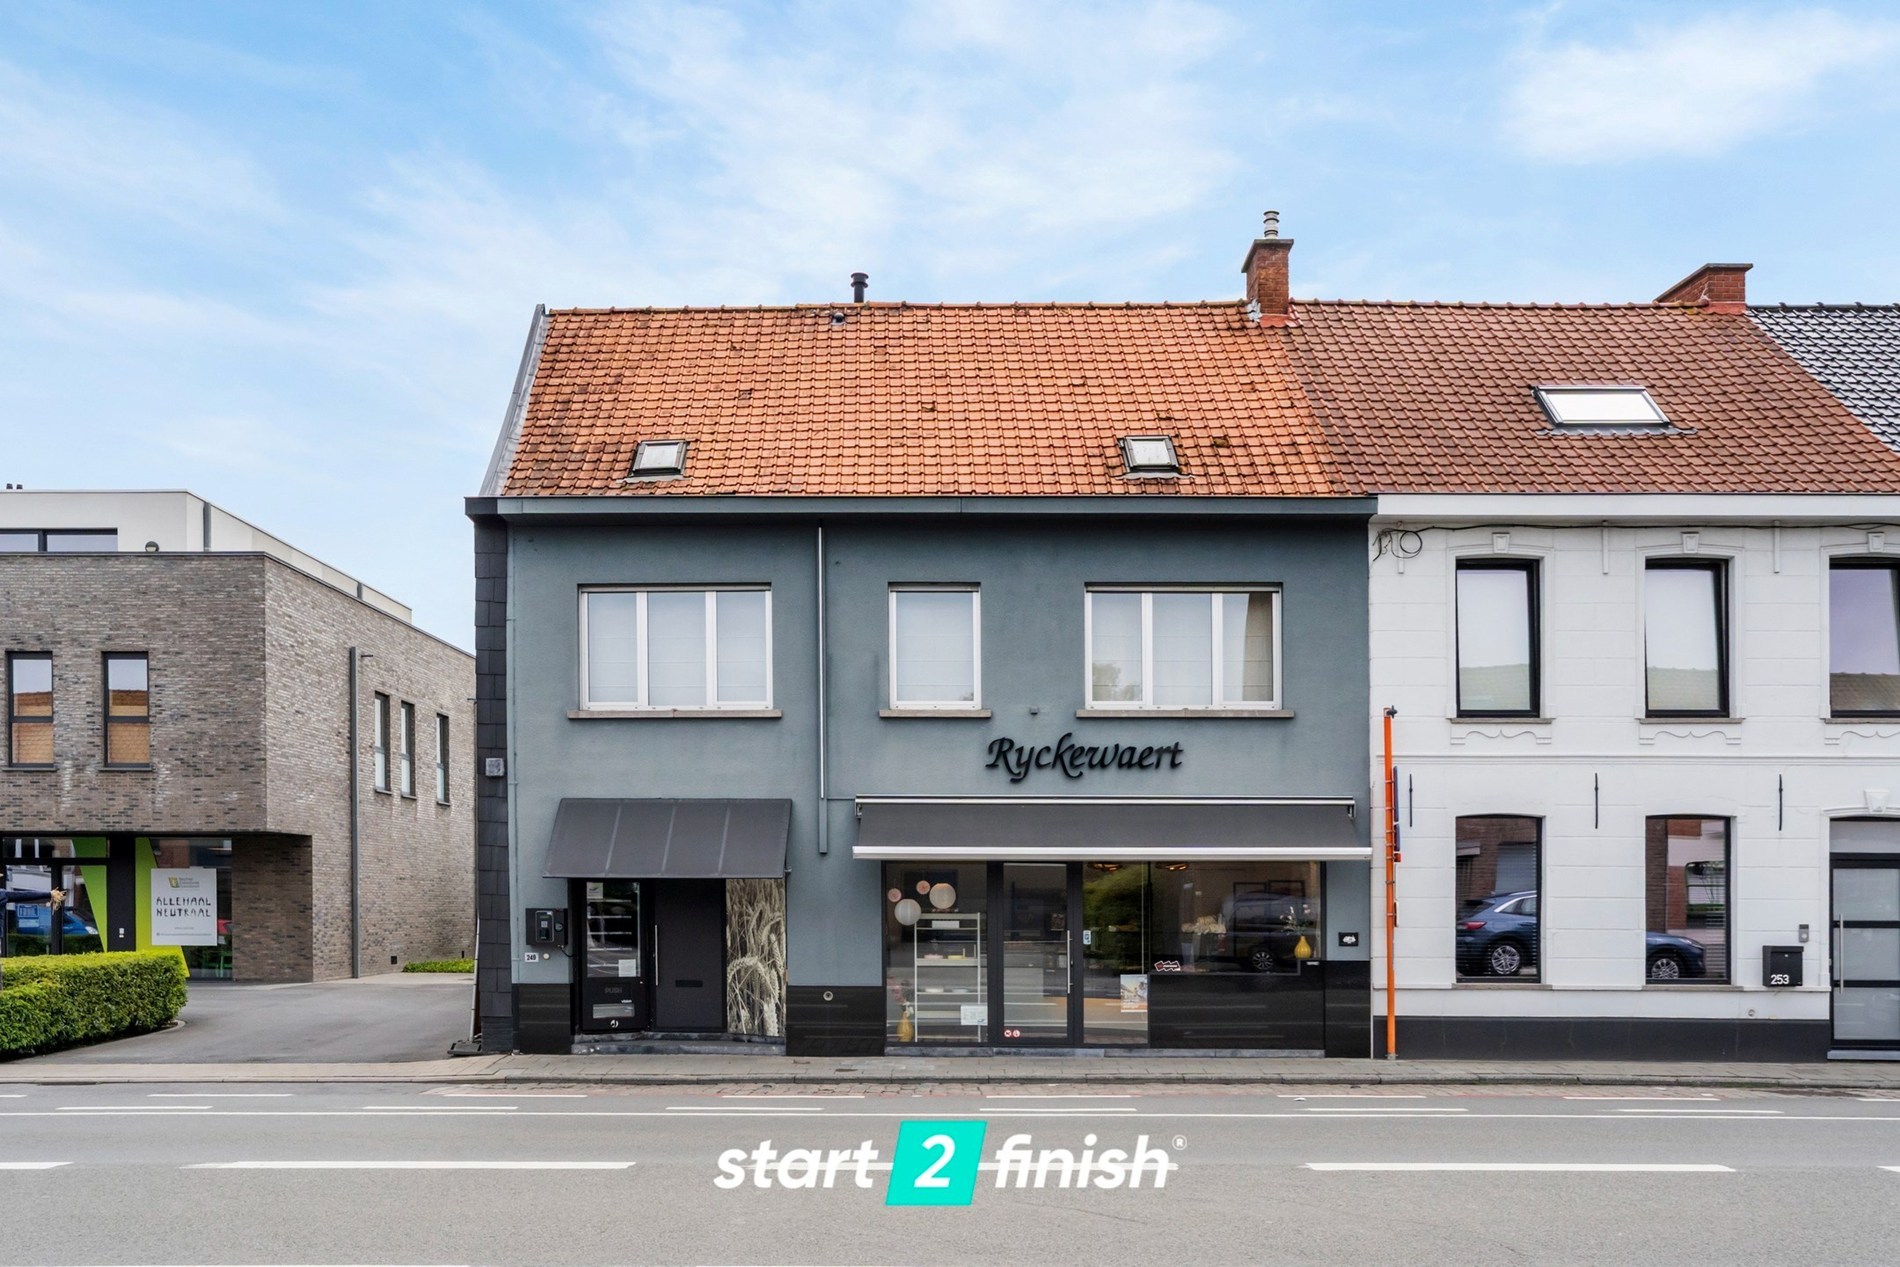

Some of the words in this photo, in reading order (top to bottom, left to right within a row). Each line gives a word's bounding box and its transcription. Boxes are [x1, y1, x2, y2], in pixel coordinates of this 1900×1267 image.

[985, 732, 1184, 783] Ryckewaert
[156, 908, 212, 918] NEUTRAAL
[1770, 974, 1790, 985] 253
